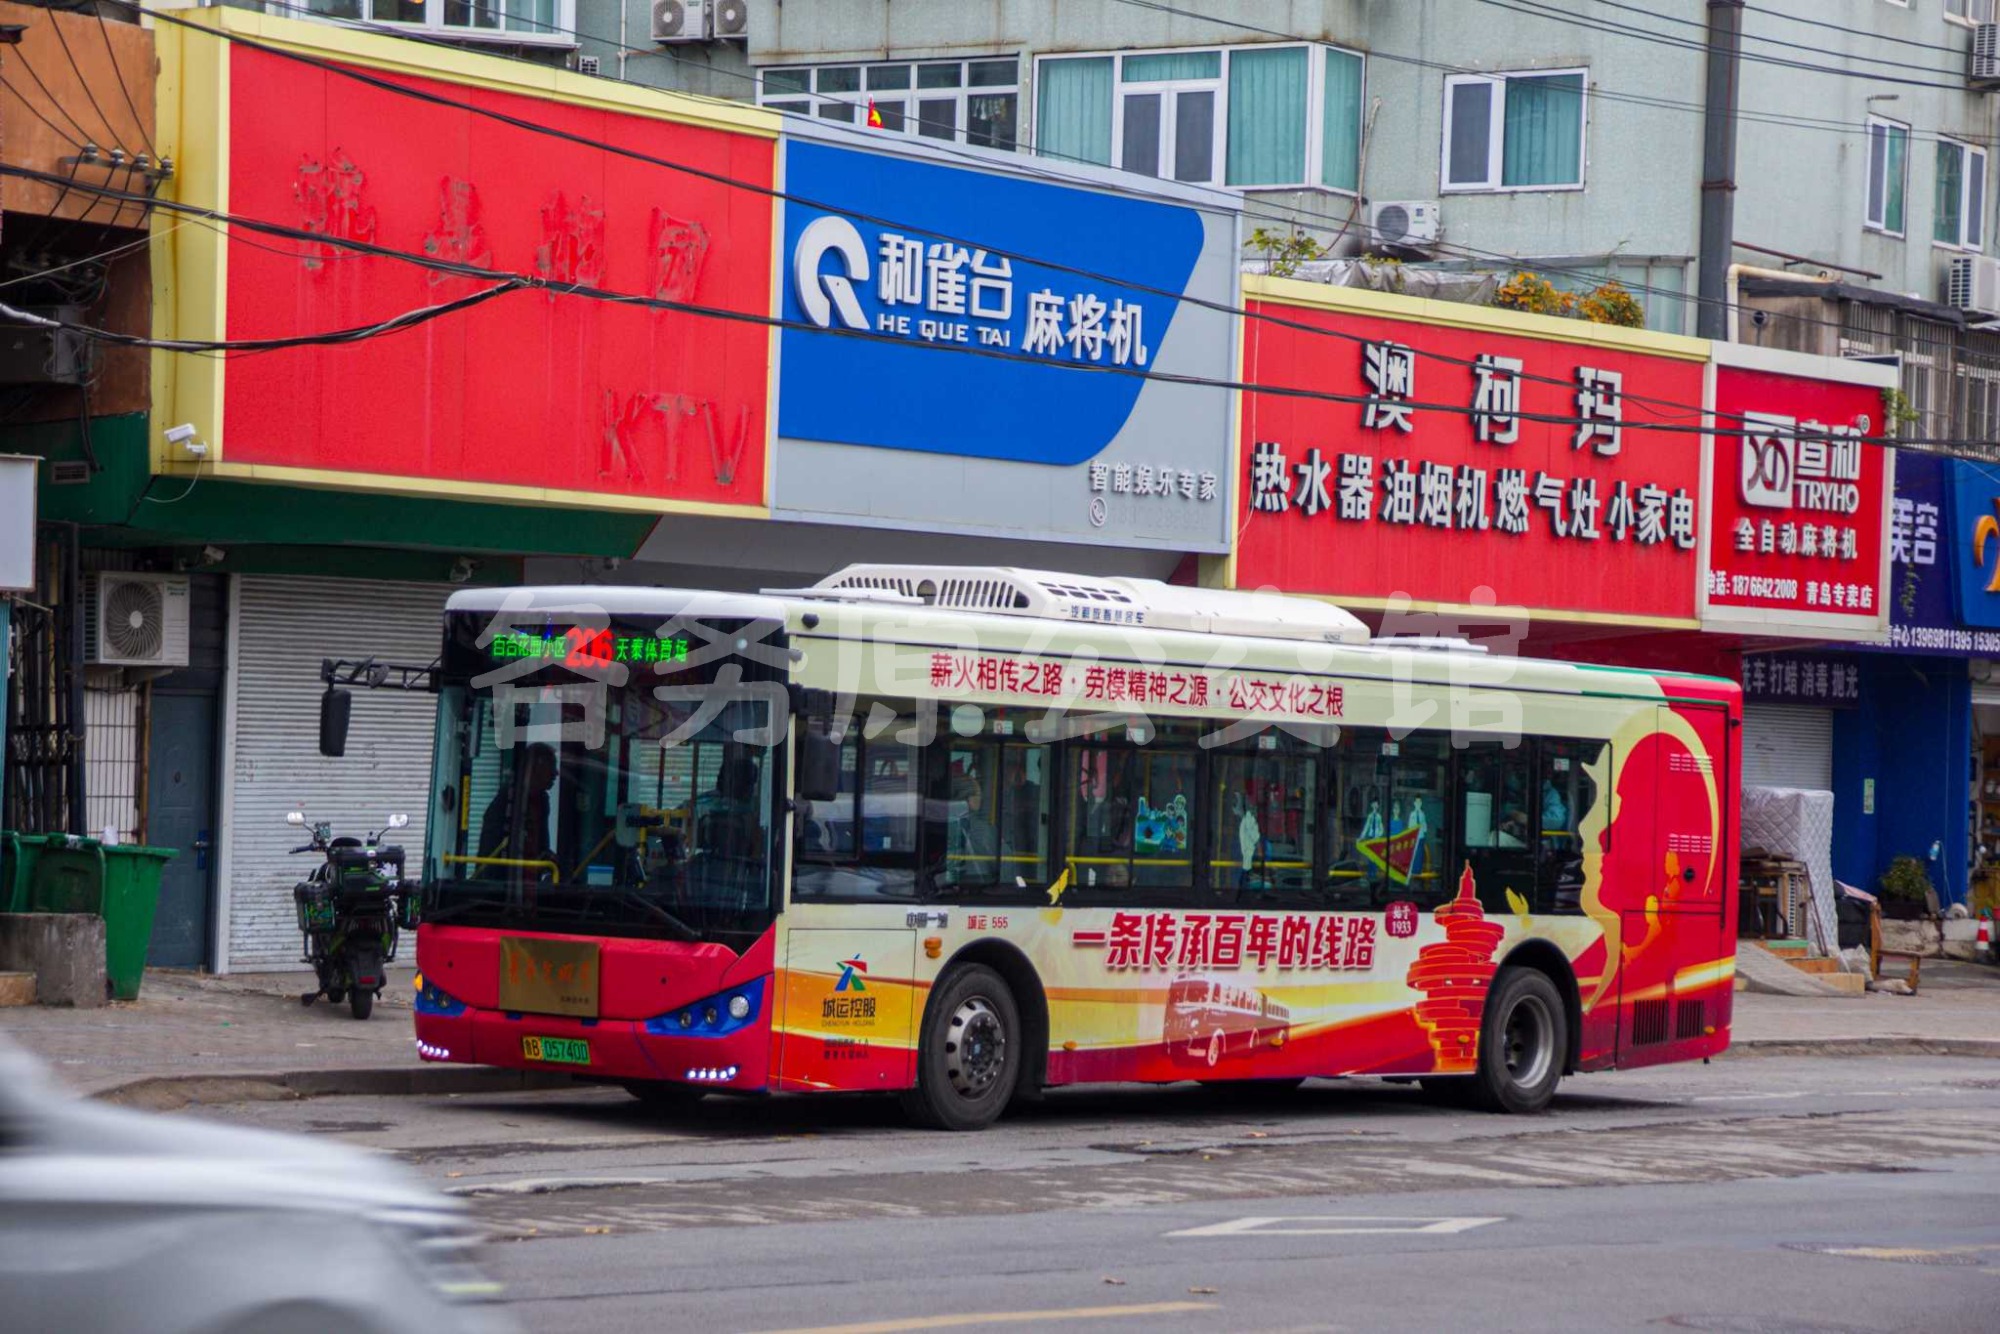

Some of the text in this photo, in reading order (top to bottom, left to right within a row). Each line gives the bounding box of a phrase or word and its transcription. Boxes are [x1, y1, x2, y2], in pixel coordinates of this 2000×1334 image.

[878, 232, 1013, 321] 和雀台
[877, 313, 1011, 348] HE QUE TAI
[1021, 288, 1147, 366] 麻将机
[1362, 340, 1624, 456] 澳柯玛
[1089, 459, 1218, 501] 智能娱乐专家
[1797, 479, 1860, 515] TRYHO
[1736, 516, 1858, 560] 全自动麻将机
[1072, 911, 1377, 970] 一条传承百年的线路
[822, 997, 876, 1018] 城运控股
